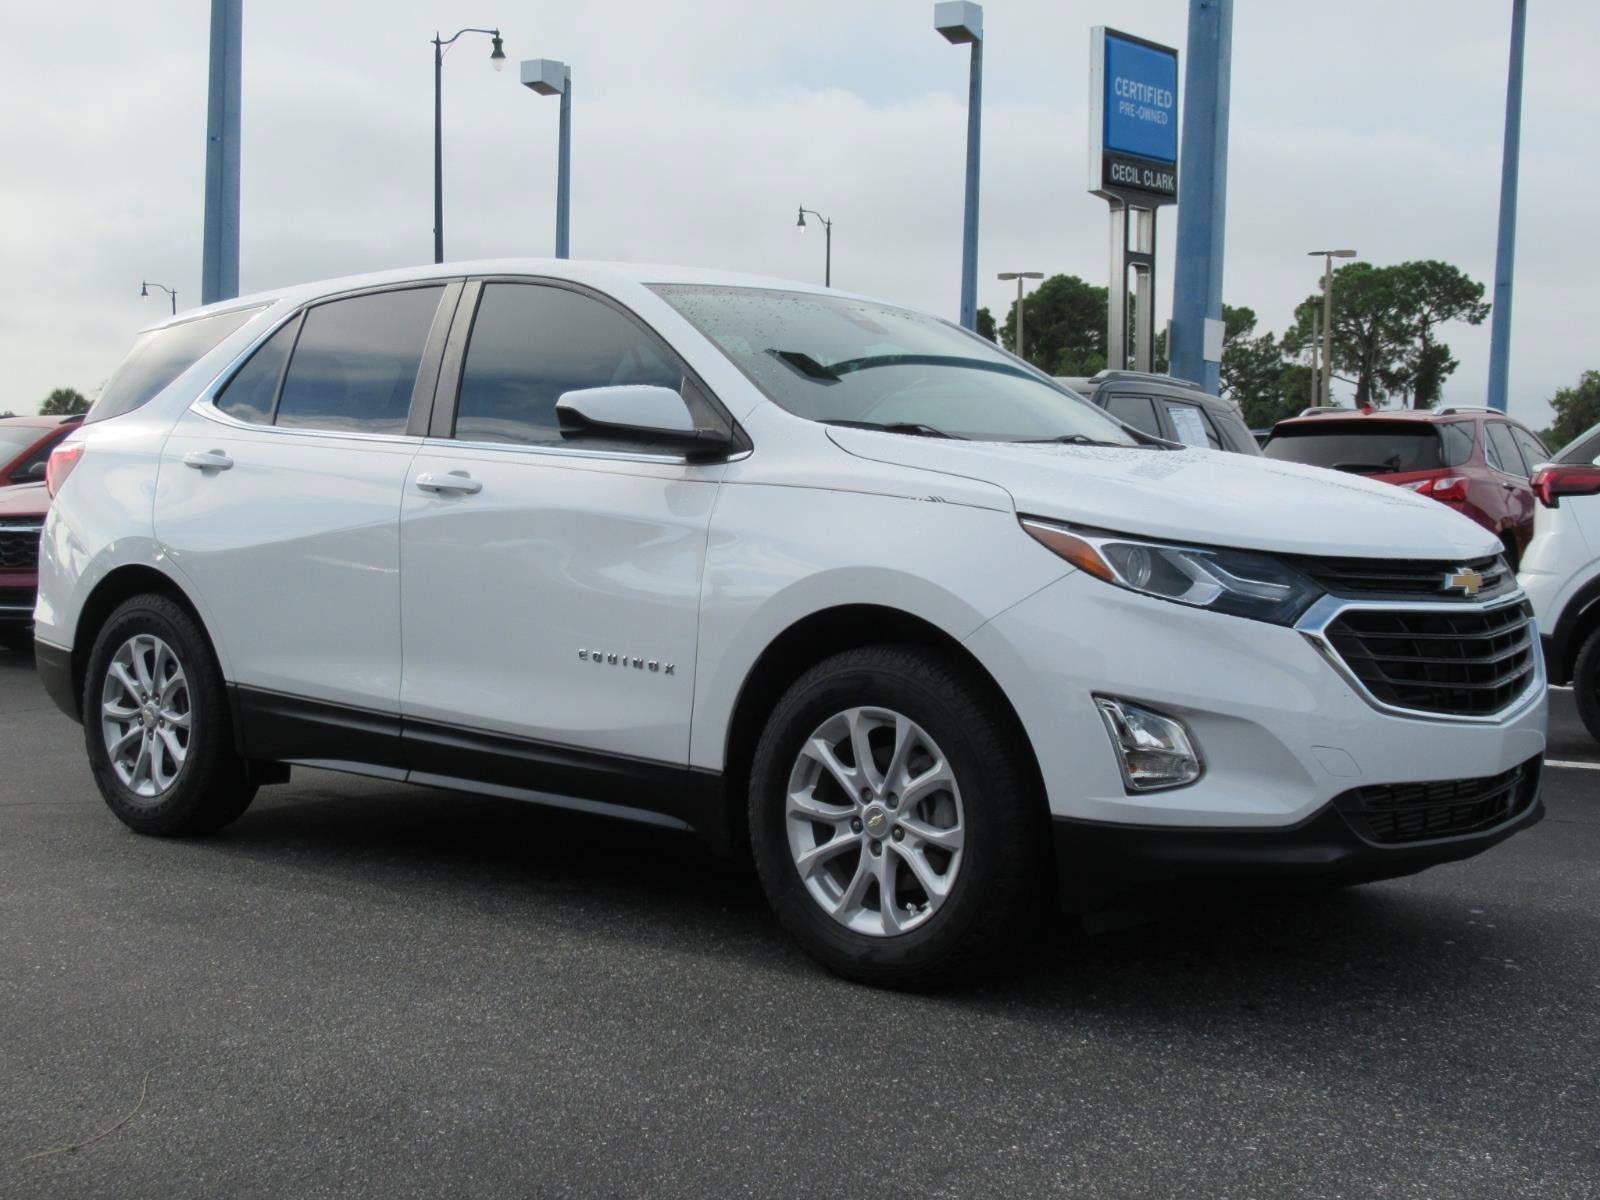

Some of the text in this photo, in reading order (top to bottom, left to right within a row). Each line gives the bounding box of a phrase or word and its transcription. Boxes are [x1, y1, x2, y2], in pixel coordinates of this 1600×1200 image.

[1114, 77, 1173, 108] CERTIFIED
[1119, 101, 1168, 125] PRE-OWNED
[1111, 163, 1174, 191] CECIL CLARK
[578, 648, 675, 675] EQUINOX
